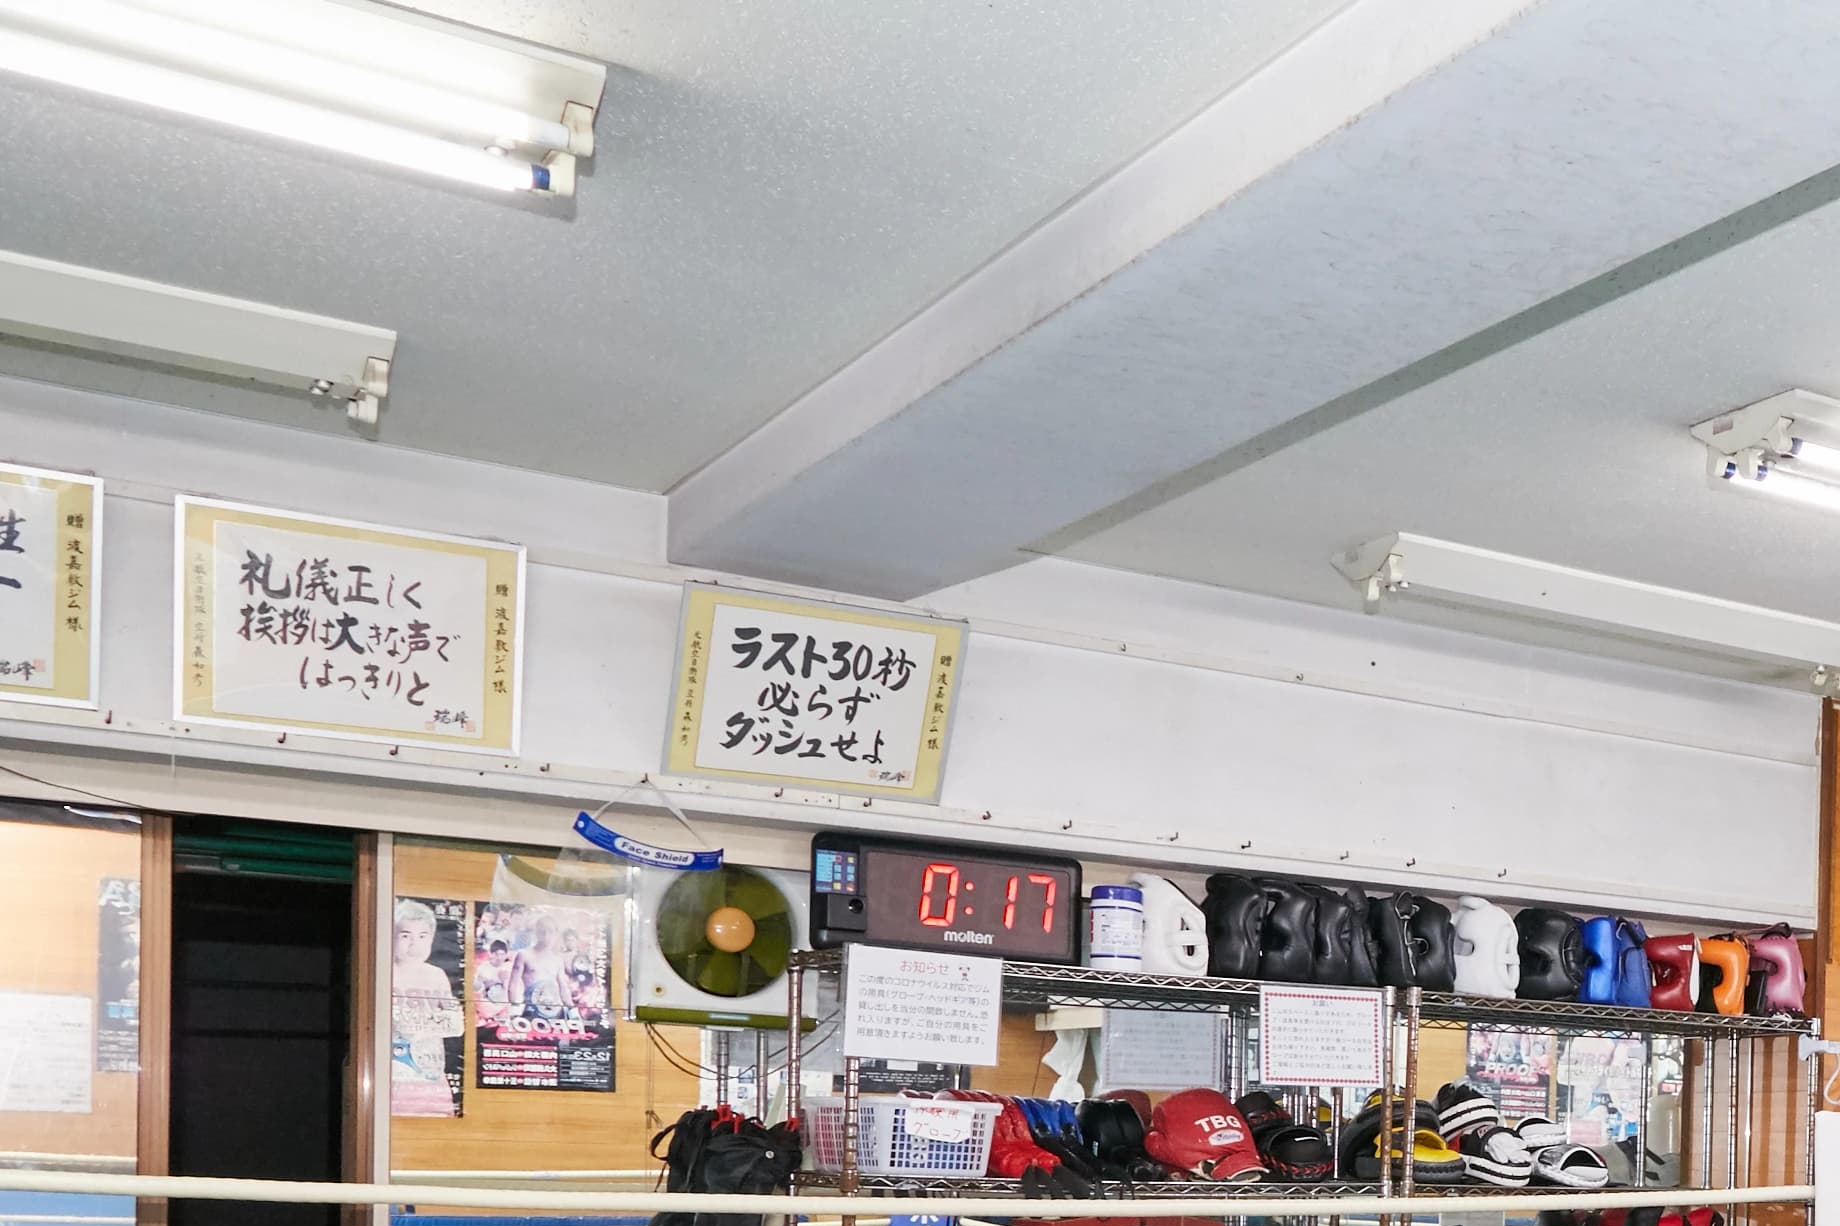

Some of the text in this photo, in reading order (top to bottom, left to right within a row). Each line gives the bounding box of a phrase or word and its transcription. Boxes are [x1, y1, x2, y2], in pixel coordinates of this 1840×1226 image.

[239, 549, 422, 609] 礼儀正しく
[236, 600, 462, 664] 挨拶は大きな声で
[299, 656, 430, 706] はっきりと
[731, 627, 917, 691] ラスト30秒
[757, 681, 881, 725] 必らず
[719, 711, 885, 764] ダッシュせよ
[621, 841, 650, 856] Face
[655, 851, 689, 863] Shield
[918, 862, 1056, 933] 0:17
[944, 930, 993, 944] molten
[900, 960, 949, 976] お知らせ
[1194, 1115, 1242, 1133] TBG
